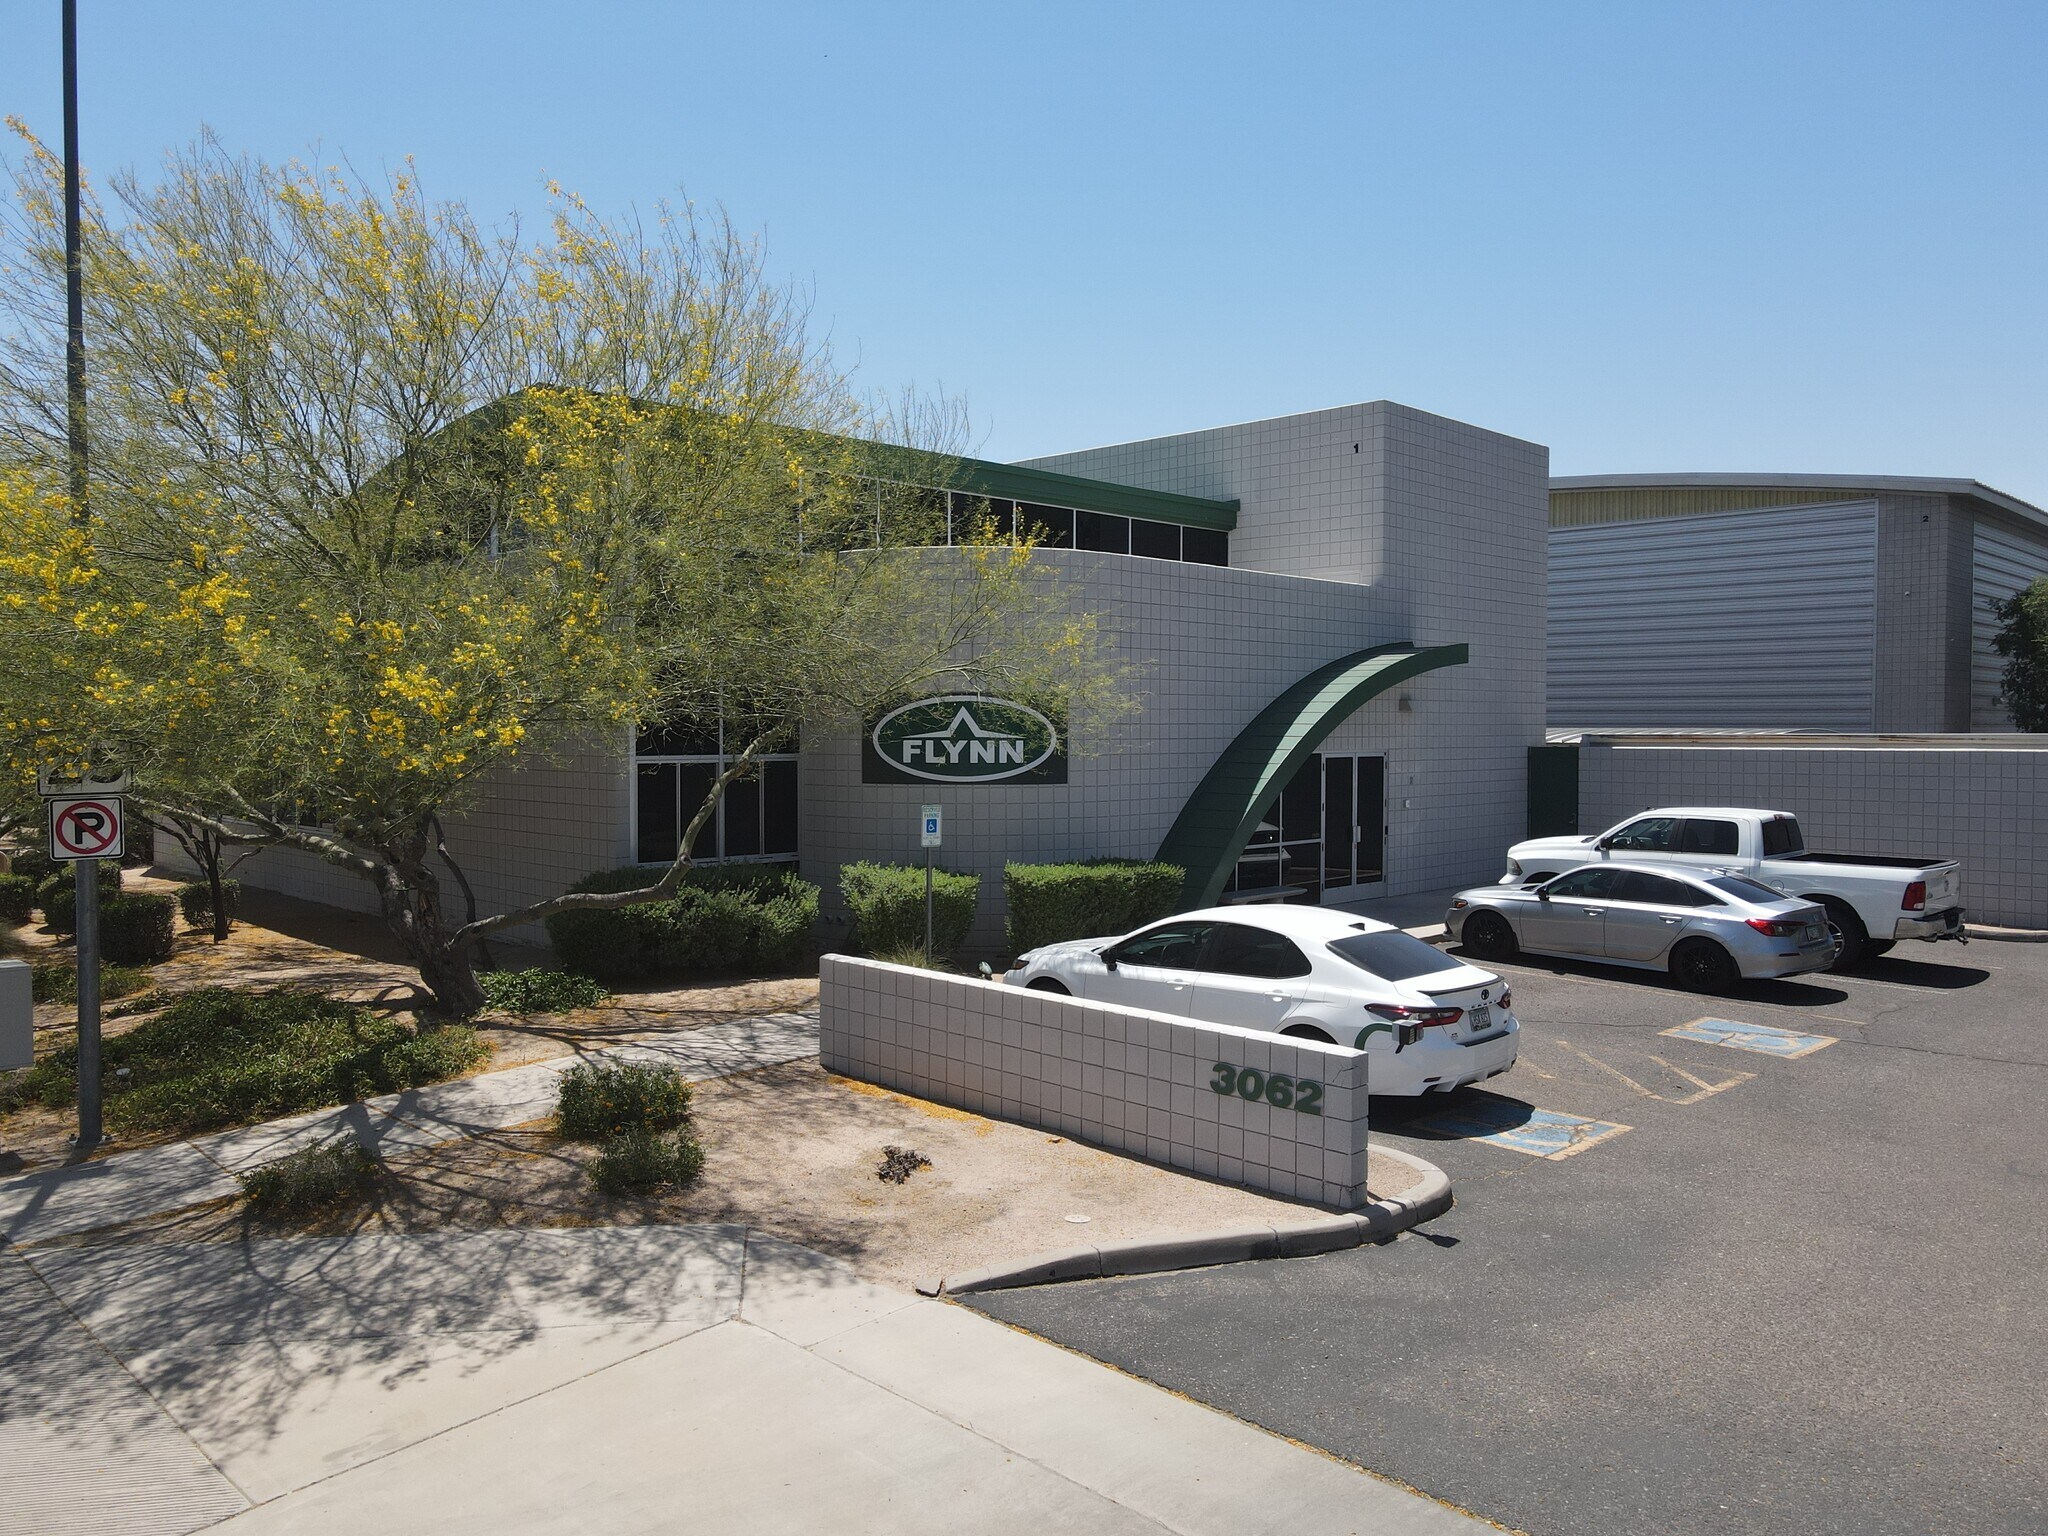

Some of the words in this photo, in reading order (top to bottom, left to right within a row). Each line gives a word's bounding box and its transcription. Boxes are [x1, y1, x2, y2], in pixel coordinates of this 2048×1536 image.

[1353, 443, 1359, 454] 1
[1922, 515, 1929, 523] 2
[902, 739, 1025, 765] FLYNN
[74, 812, 105, 845] P
[1209, 1062, 1323, 1116] 3062
